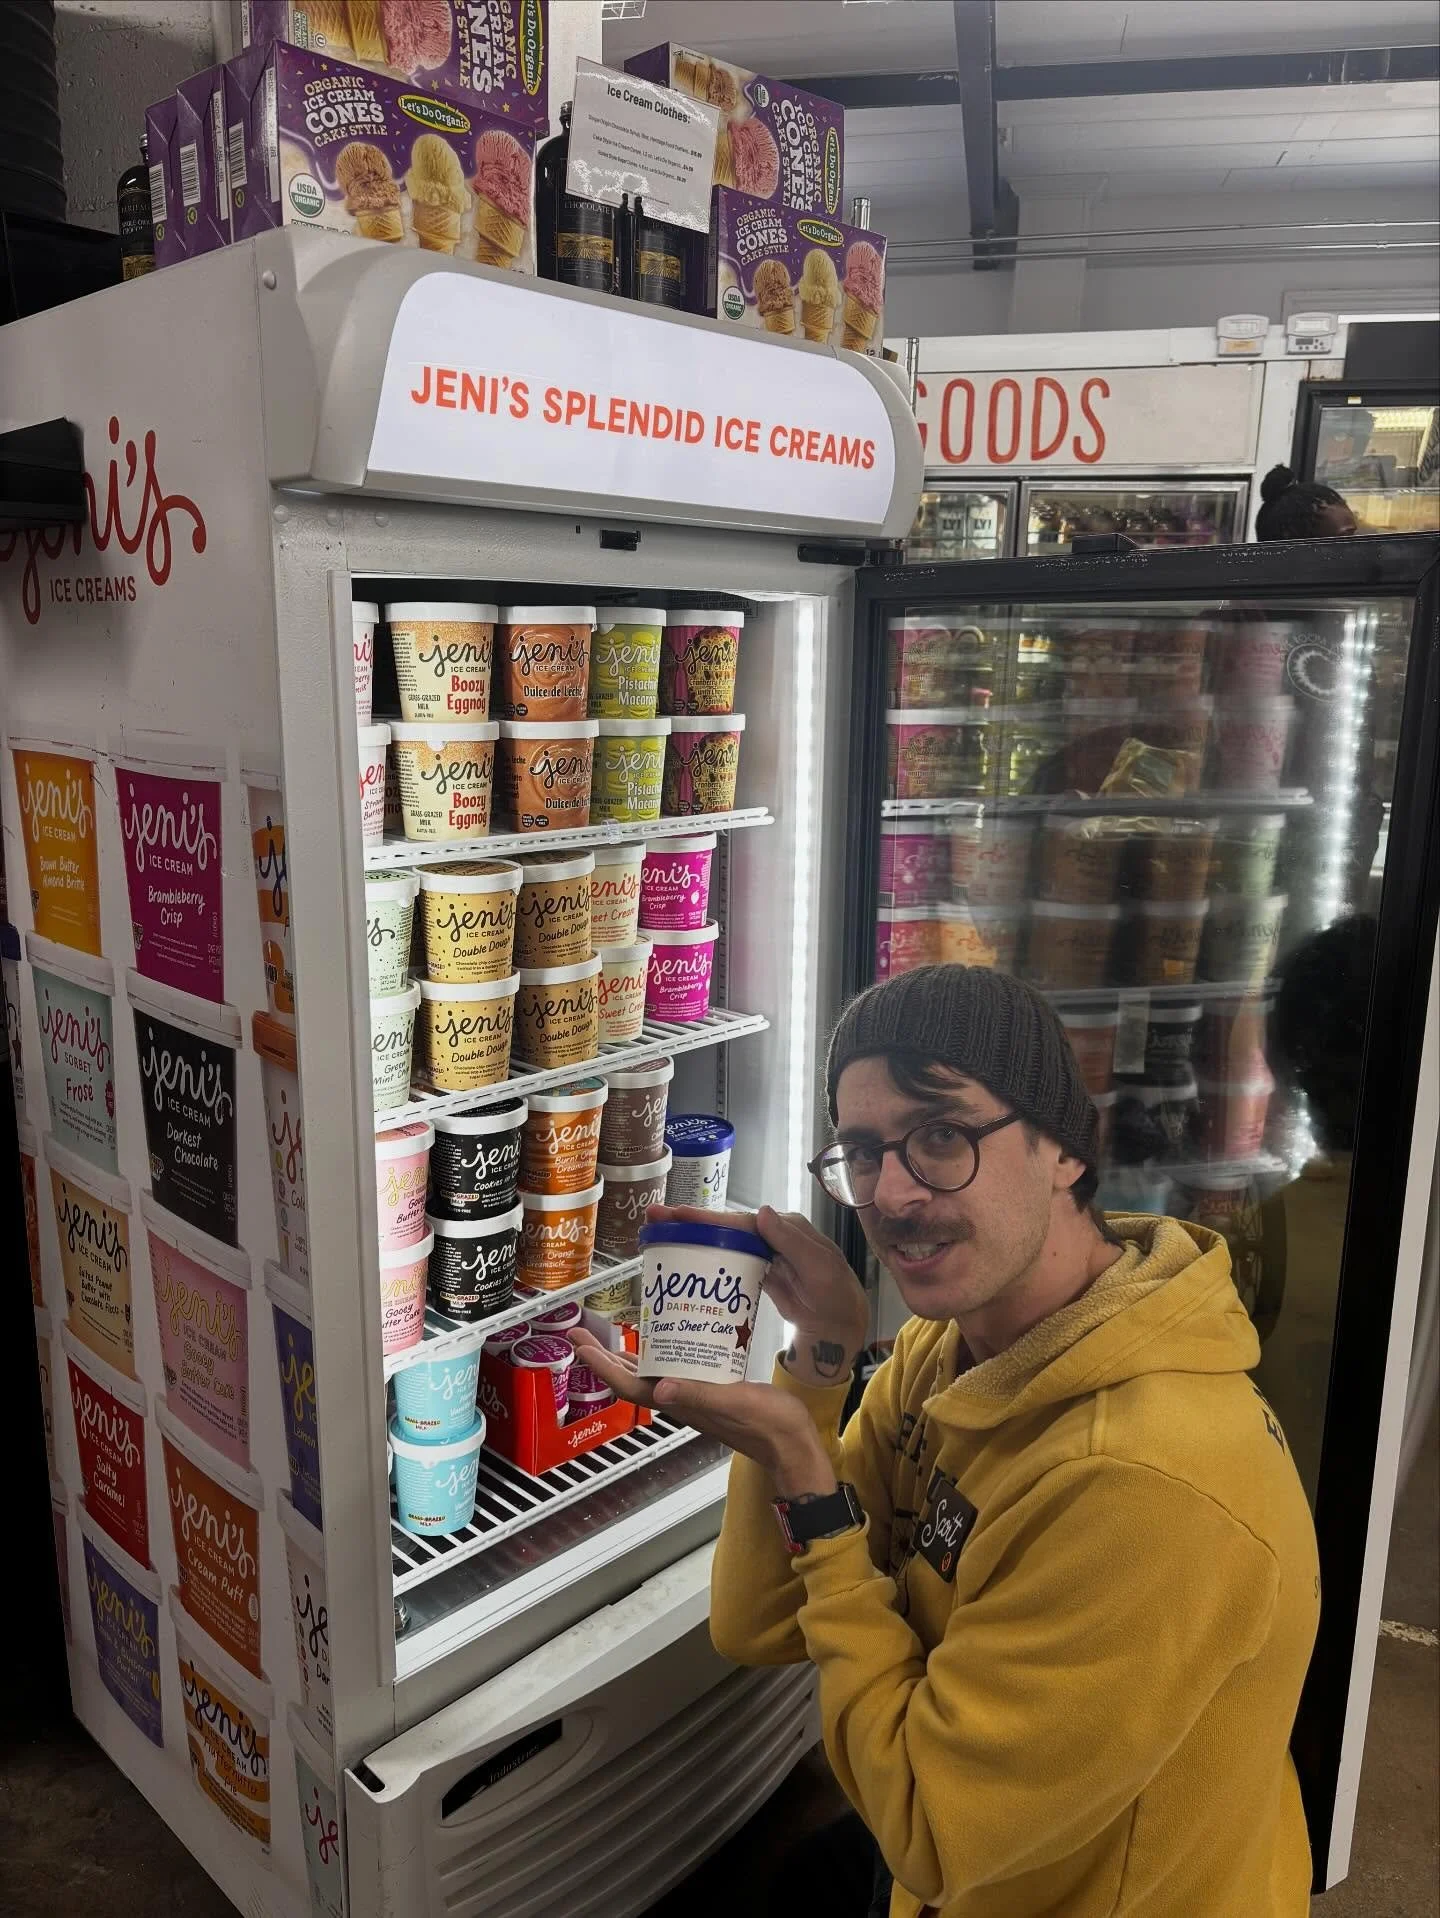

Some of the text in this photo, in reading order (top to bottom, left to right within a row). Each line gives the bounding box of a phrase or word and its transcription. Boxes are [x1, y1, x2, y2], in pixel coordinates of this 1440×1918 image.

[457, 15, 471, 88] STYLE
[467, 0, 493, 93] NES
[488, 0, 505, 90] CREAM
[501, 0, 517, 79] GANIC
[525, 18, 537, 90] Do Organic
[304, 76, 365, 96] ORGANIC
[302, 89, 376, 113] ICE CREAM
[607, 83, 691, 125] Ice Cream Clothes:
[305, 101, 386, 134] CONES
[400, 97, 471, 131] Let's Do Organic
[314, 123, 388, 148] CAKE STYLE
[772, 102, 789, 152] CAKE
[780, 99, 805, 212] CONES
[795, 103, 814, 213] ICE CREAM
[805, 112, 822, 203] ORGANIC
[296, 181, 317, 196] USDA
[828, 155, 838, 212] Do Organic
[293, 194, 320, 209] ORGANIC
[735, 218, 782, 240] ICE CREAM
[736, 208, 777, 227] ORGANIC
[736, 227, 788, 256] CONES
[812, 226, 821, 237] Do
[741, 244, 790, 266] CAKE STYLE
[410, 365, 876, 470] JENI'S SPLENDID ICE CREAMS
[50, 575, 137, 603] ICE CREAMS
[508, 635, 590, 677] jeni's
[535, 664, 576, 673] ICE CREAM
[451, 674, 486, 695] Boozy
[523, 685, 584, 699] Dulce de Leche
[447, 693, 487, 714] Eggnog
[452, 782, 466, 790] ICE
[21, 761, 94, 844] jeni's
[453, 791, 487, 812] Boozy
[545, 797, 581, 810] Dulce de
[42, 824, 77, 842] ICE CREAM
[124, 783, 218, 873] jeni's
[448, 810, 488, 831] Eggnog
[149, 853, 194, 877] ICE CREAM
[641, 862, 700, 890] eni's
[148, 885, 206, 916] Brambleberry
[649, 900, 667, 910] Crisp
[160, 908, 184, 928] Crisp
[436, 898, 516, 942] jeni's
[481, 928, 505, 938] CREAM
[538, 926, 570, 943] Double
[453, 944, 487, 958] Double
[649, 951, 713, 985] jeni's
[678, 974, 699, 982] CREAM
[659, 981, 704, 994] Brambleberry
[669, 992, 688, 1001] Crisp
[523, 987, 597, 1029] jeni's
[549, 1013, 586, 1025] ICE CREAM
[600, 1005, 626, 1020] Sweet
[41, 987, 111, 1073] jeni's
[435, 1006, 514, 1047] jeni's
[539, 1019, 593, 1044] Double Dough
[64, 1051, 92, 1076] SORBET
[384, 1061, 406, 1074] Green
[451, 1049, 485, 1063] Double
[143, 1027, 234, 1126] jeni's
[373, 1073, 394, 1085] Mint
[66, 1076, 95, 1103] Frosé
[167, 1096, 212, 1129] ICE CREAM
[166, 1122, 203, 1149] Darkest
[563, 1143, 575, 1151] ICE
[174, 1145, 220, 1171] Chocolate
[555, 1155, 580, 1166] Burnt
[474, 1179, 503, 1192] Cookies
[57, 1182, 129, 1273] jeni's
[396, 1208, 420, 1225] Butter
[541, 1240, 567, 1248] CREAM
[547, 1248, 576, 1260] Orange
[78, 1242, 112, 1274] ICE CREAM
[490, 1266, 501, 1275] ICE
[474, 1278, 502, 1292] Cookies
[644, 1262, 752, 1316] jeni's
[385, 1302, 414, 1319] Gooey
[666, 1301, 725, 1317] DAIRY-FREE
[650, 1319, 735, 1336] Texas Sheet Cake
[71, 1369, 141, 1467] jeni's
[568, 1419, 607, 1448] jeni's
[88, 1430, 123, 1467] ICE CREAM
[95, 1454, 118, 1488] Salty
[93, 1473, 126, 1508] Caramel
[169, 1466, 256, 1579] jeni's
[193, 1535, 236, 1577] ICE CREAM
[187, 1547, 244, 1603] Cream Puff
[183, 1660, 267, 1777] jeni's
